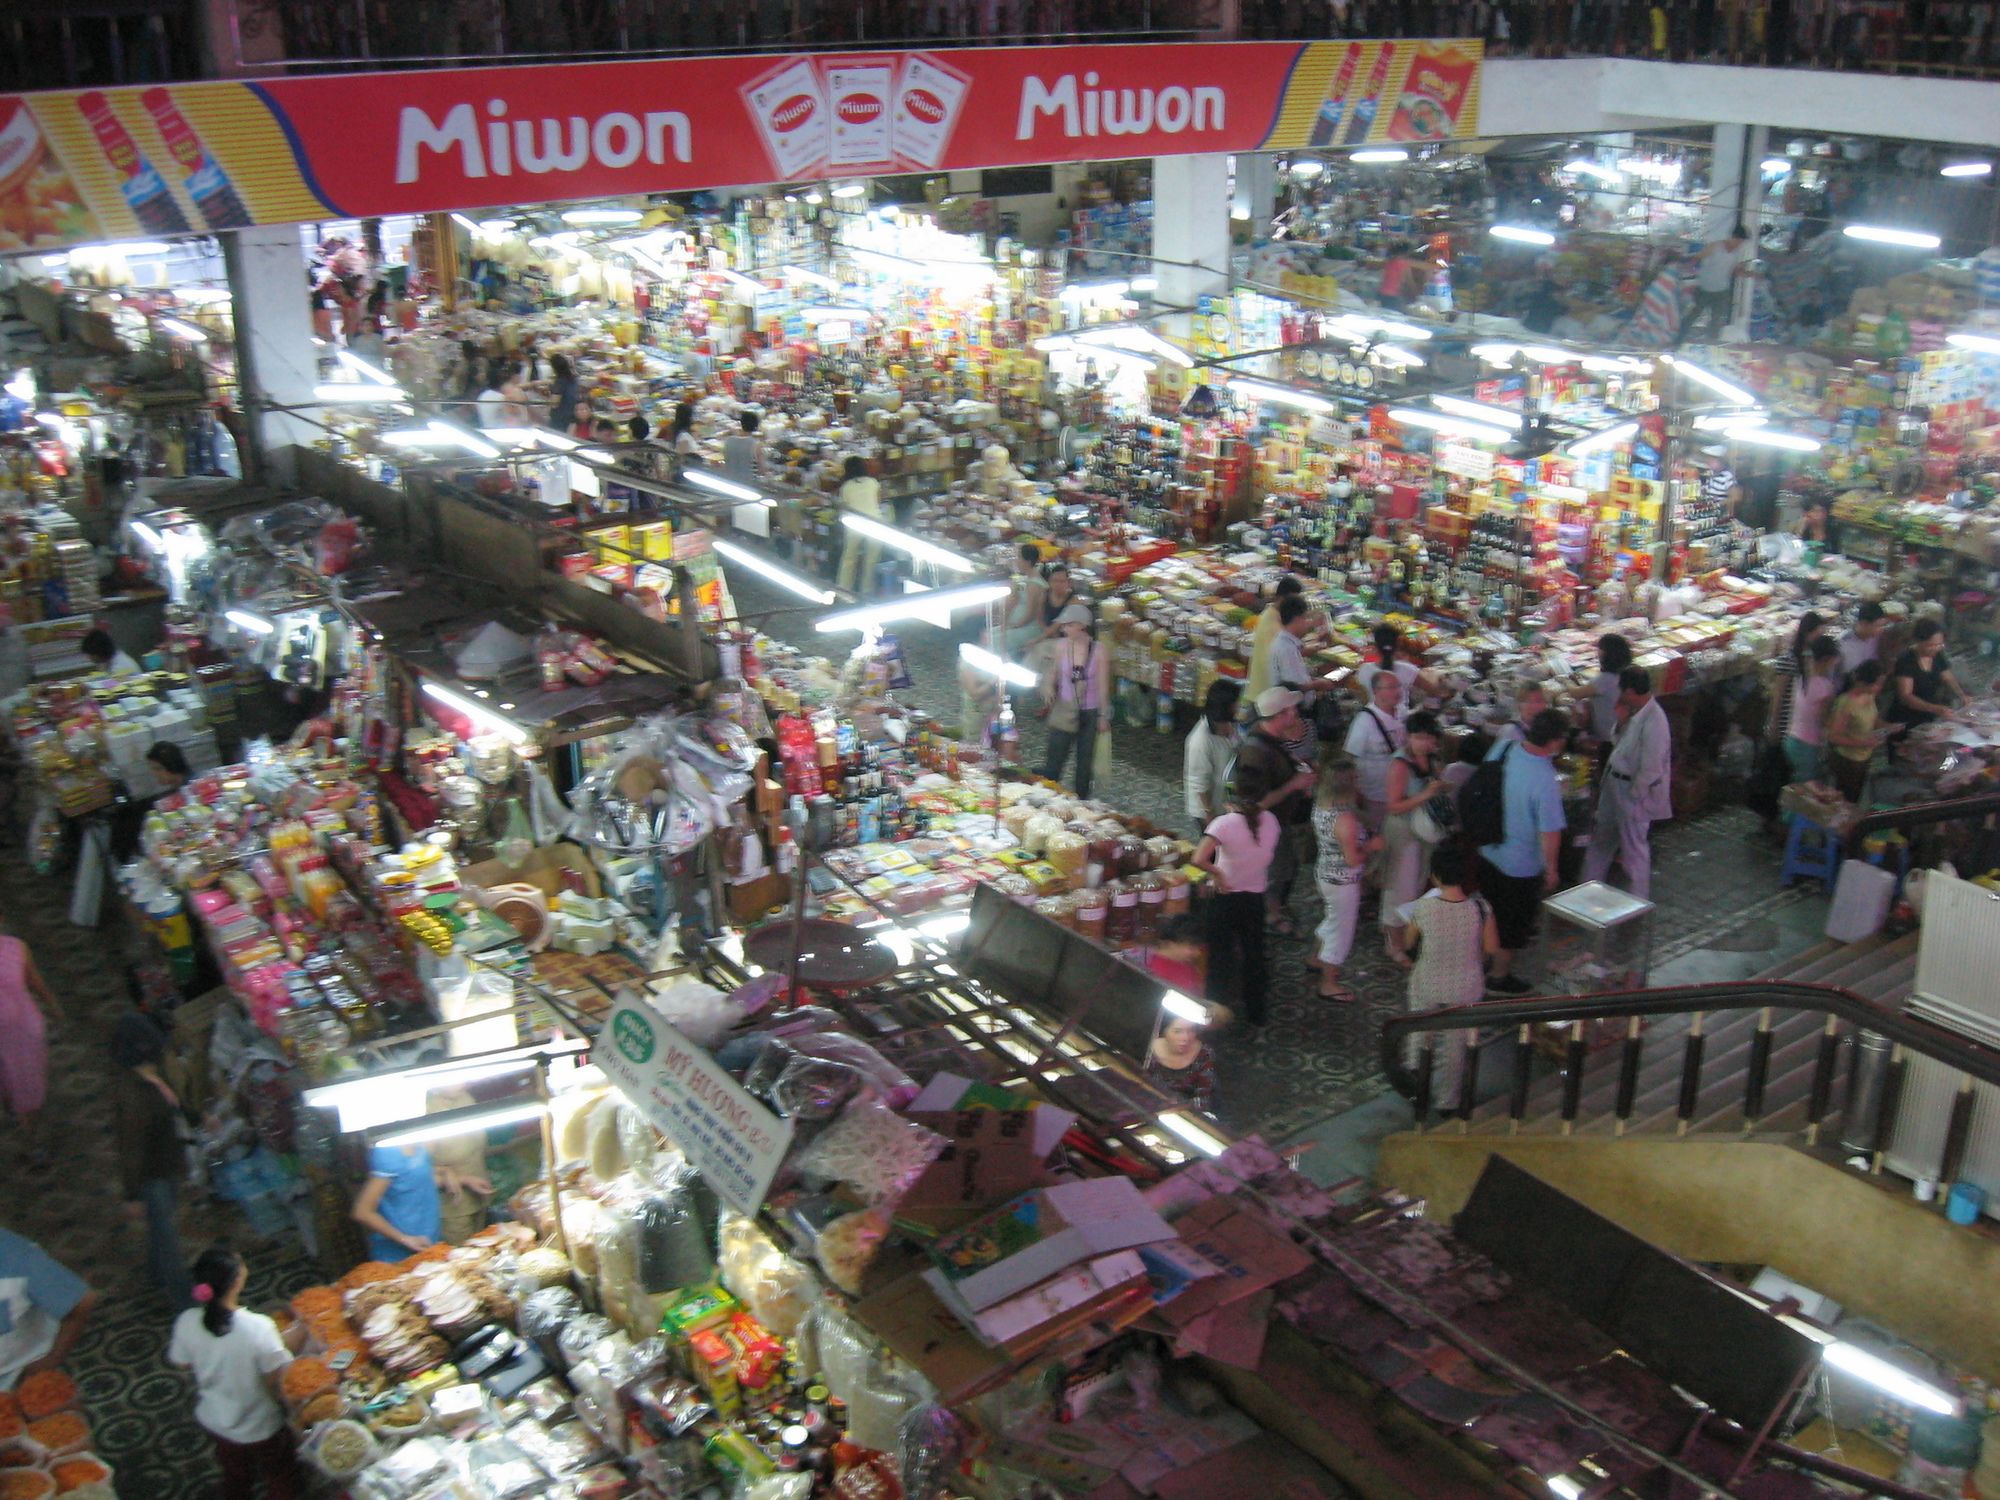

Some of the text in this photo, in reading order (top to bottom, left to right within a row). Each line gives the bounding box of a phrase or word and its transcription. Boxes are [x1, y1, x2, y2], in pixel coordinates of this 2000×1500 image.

[772, 98, 817, 130] Miwon
[839, 100, 882, 115] Miwon
[905, 92, 946, 121] Miwon
[1015, 71, 1225, 140] Miwon
[396, 99, 693, 184] Miwon
